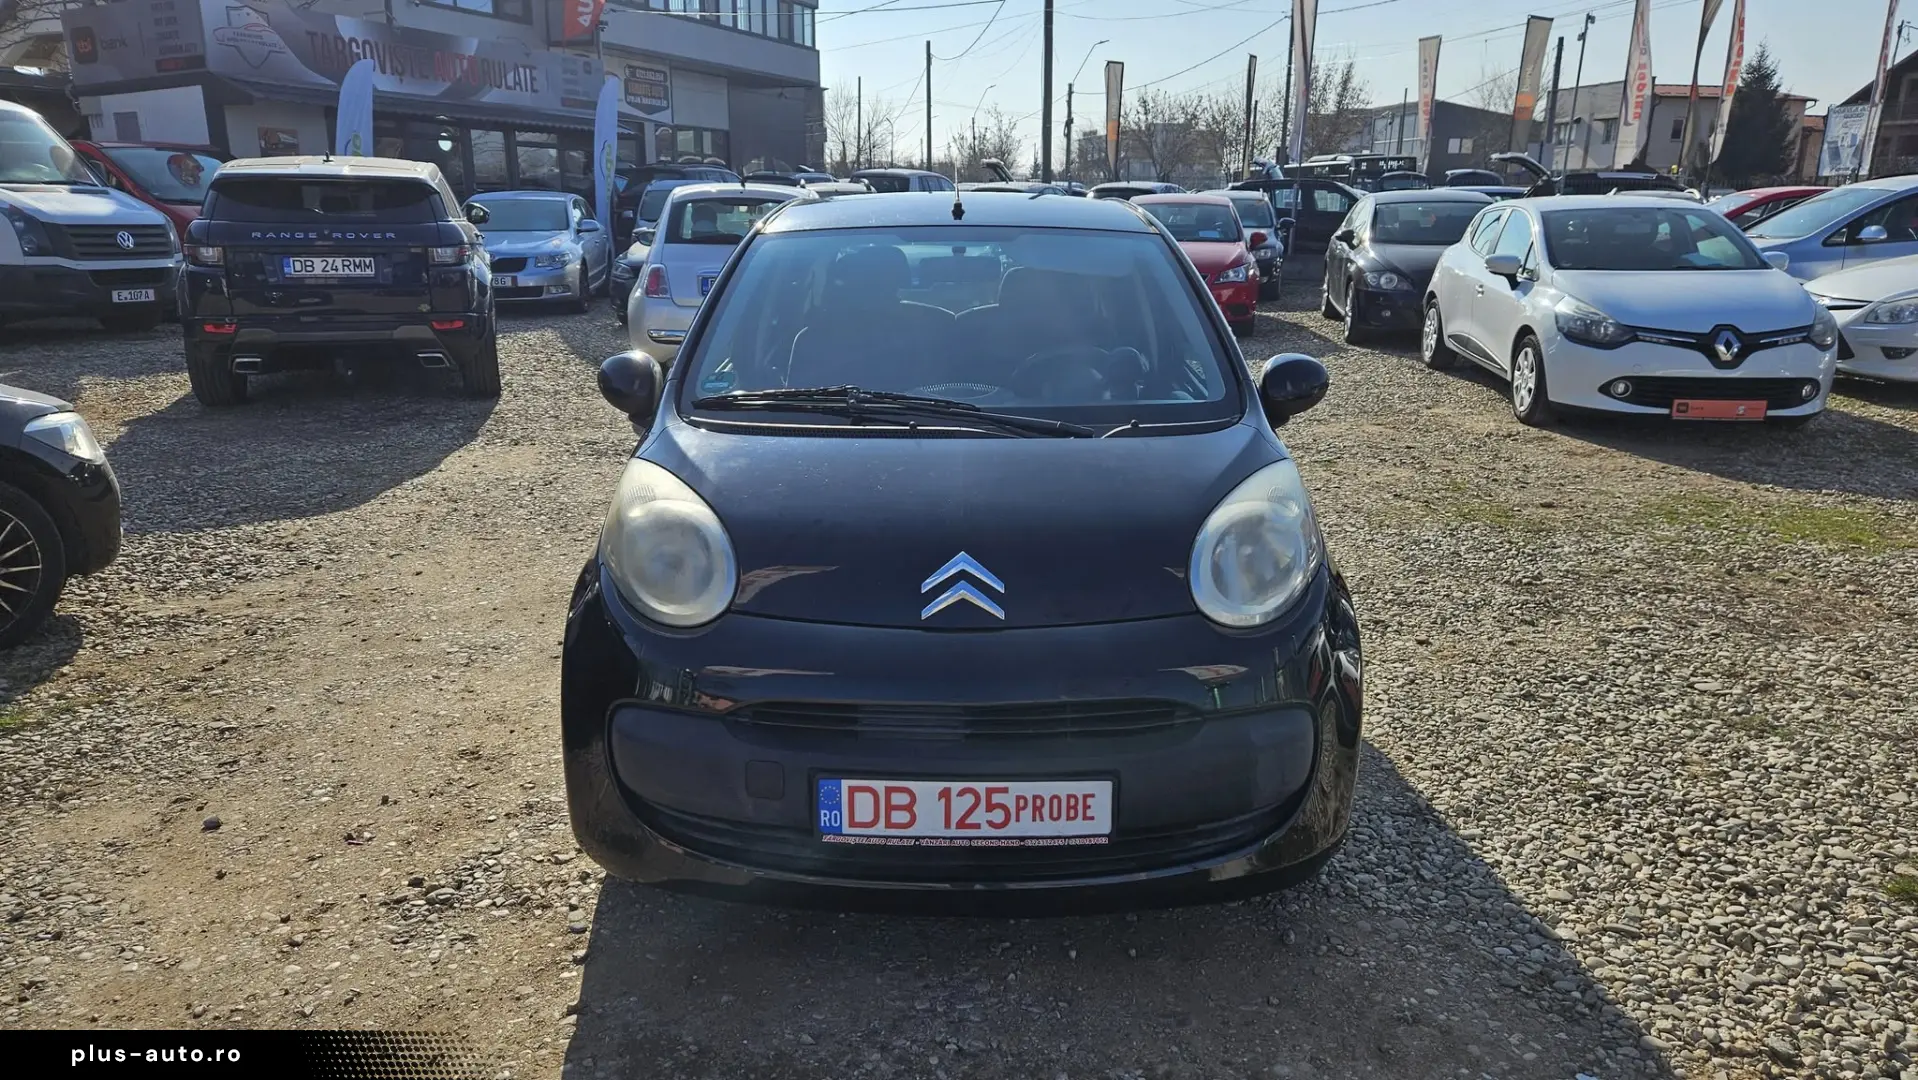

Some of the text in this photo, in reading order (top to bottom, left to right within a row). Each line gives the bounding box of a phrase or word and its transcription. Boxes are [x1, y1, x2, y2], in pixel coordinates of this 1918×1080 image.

[434, 50, 478, 86] AUTO
[481, 57, 540, 94] RULATE
[251, 231, 396, 240] RANGE ROVER
[292, 257, 374, 273] DB 24 RMM
[847, 785, 1096, 830] DB 125 PROBE
[820, 809, 840, 827] RO
